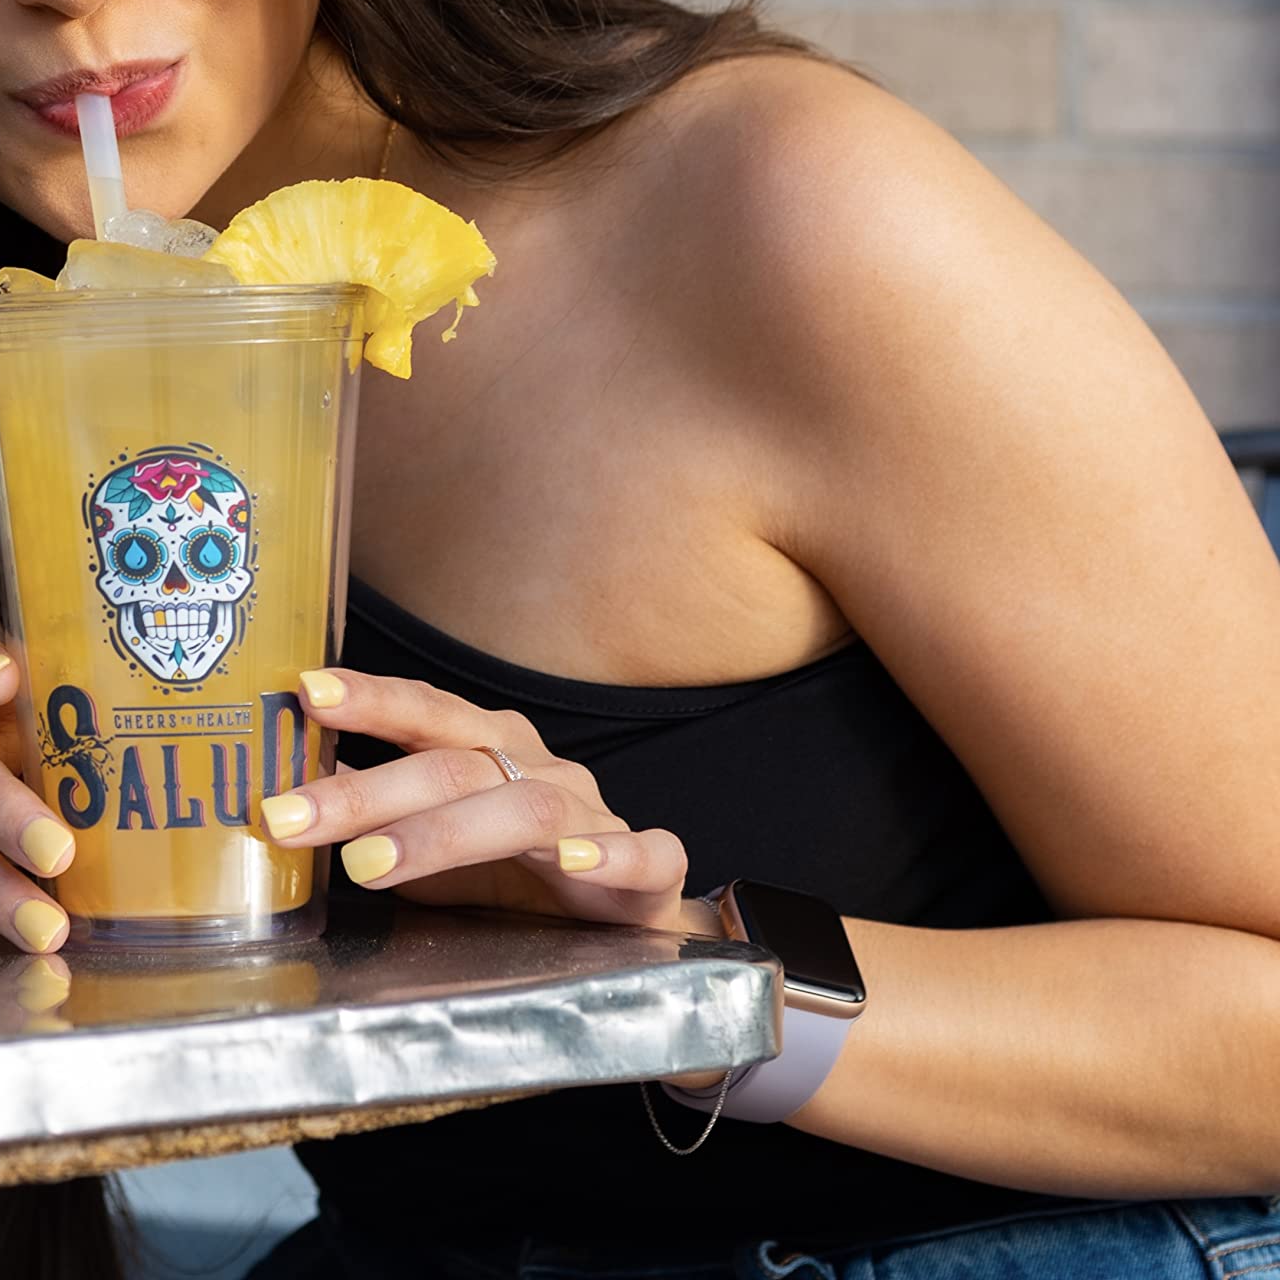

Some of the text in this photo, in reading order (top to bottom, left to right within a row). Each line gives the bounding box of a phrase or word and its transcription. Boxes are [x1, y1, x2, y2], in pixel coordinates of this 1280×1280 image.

[114, 710, 251, 729] CHEERS TO HEALTH
